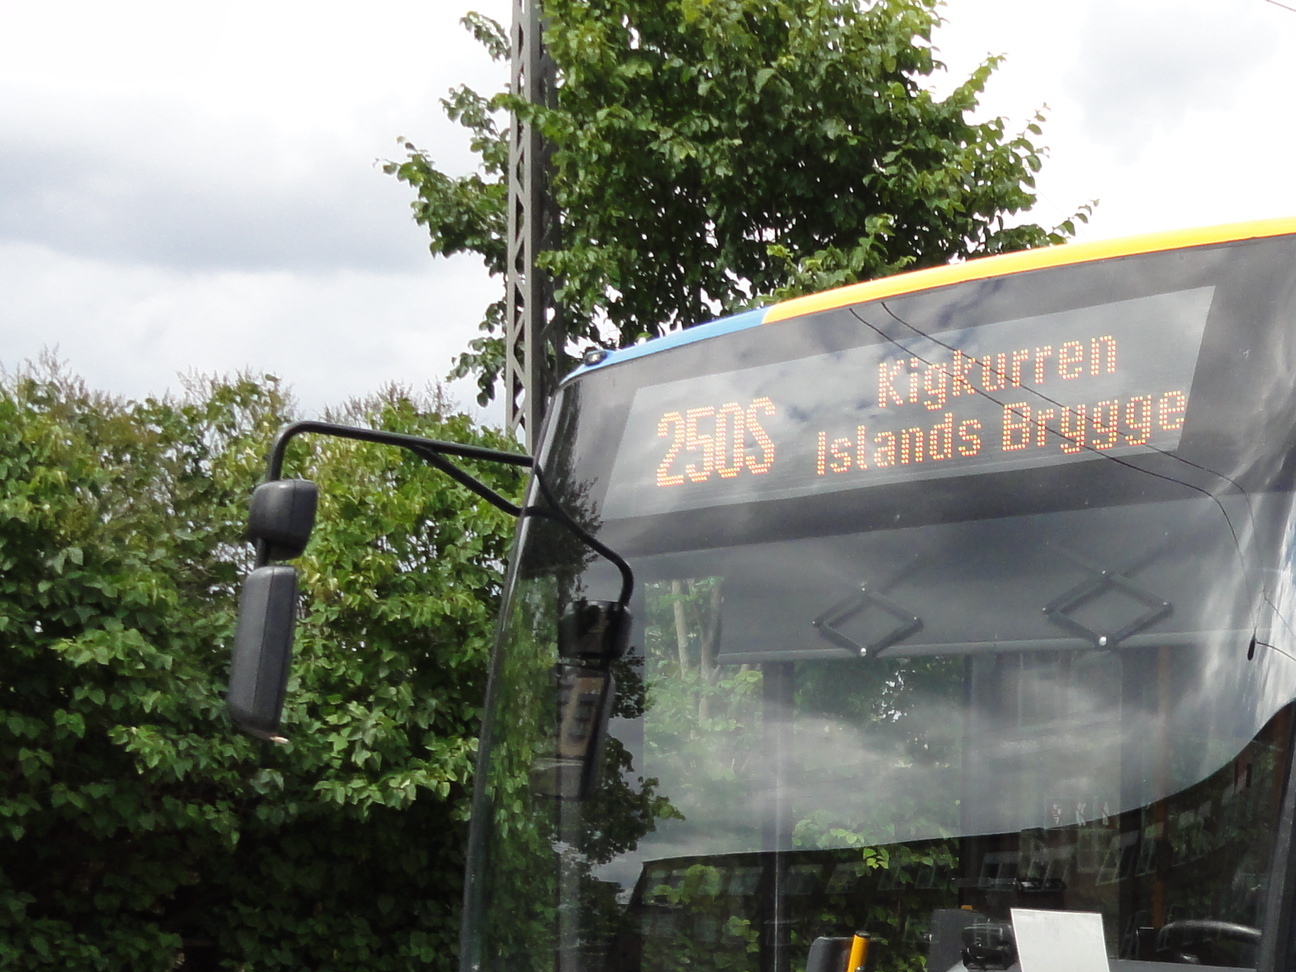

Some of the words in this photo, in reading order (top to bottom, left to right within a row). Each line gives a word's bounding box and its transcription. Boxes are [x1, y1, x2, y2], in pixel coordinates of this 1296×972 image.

[878, 333, 1117, 410] Kigkurren
[655, 396, 777, 488] 250S
[816, 413, 982, 475] Islands
[1002, 388, 1188, 454] Brygge
